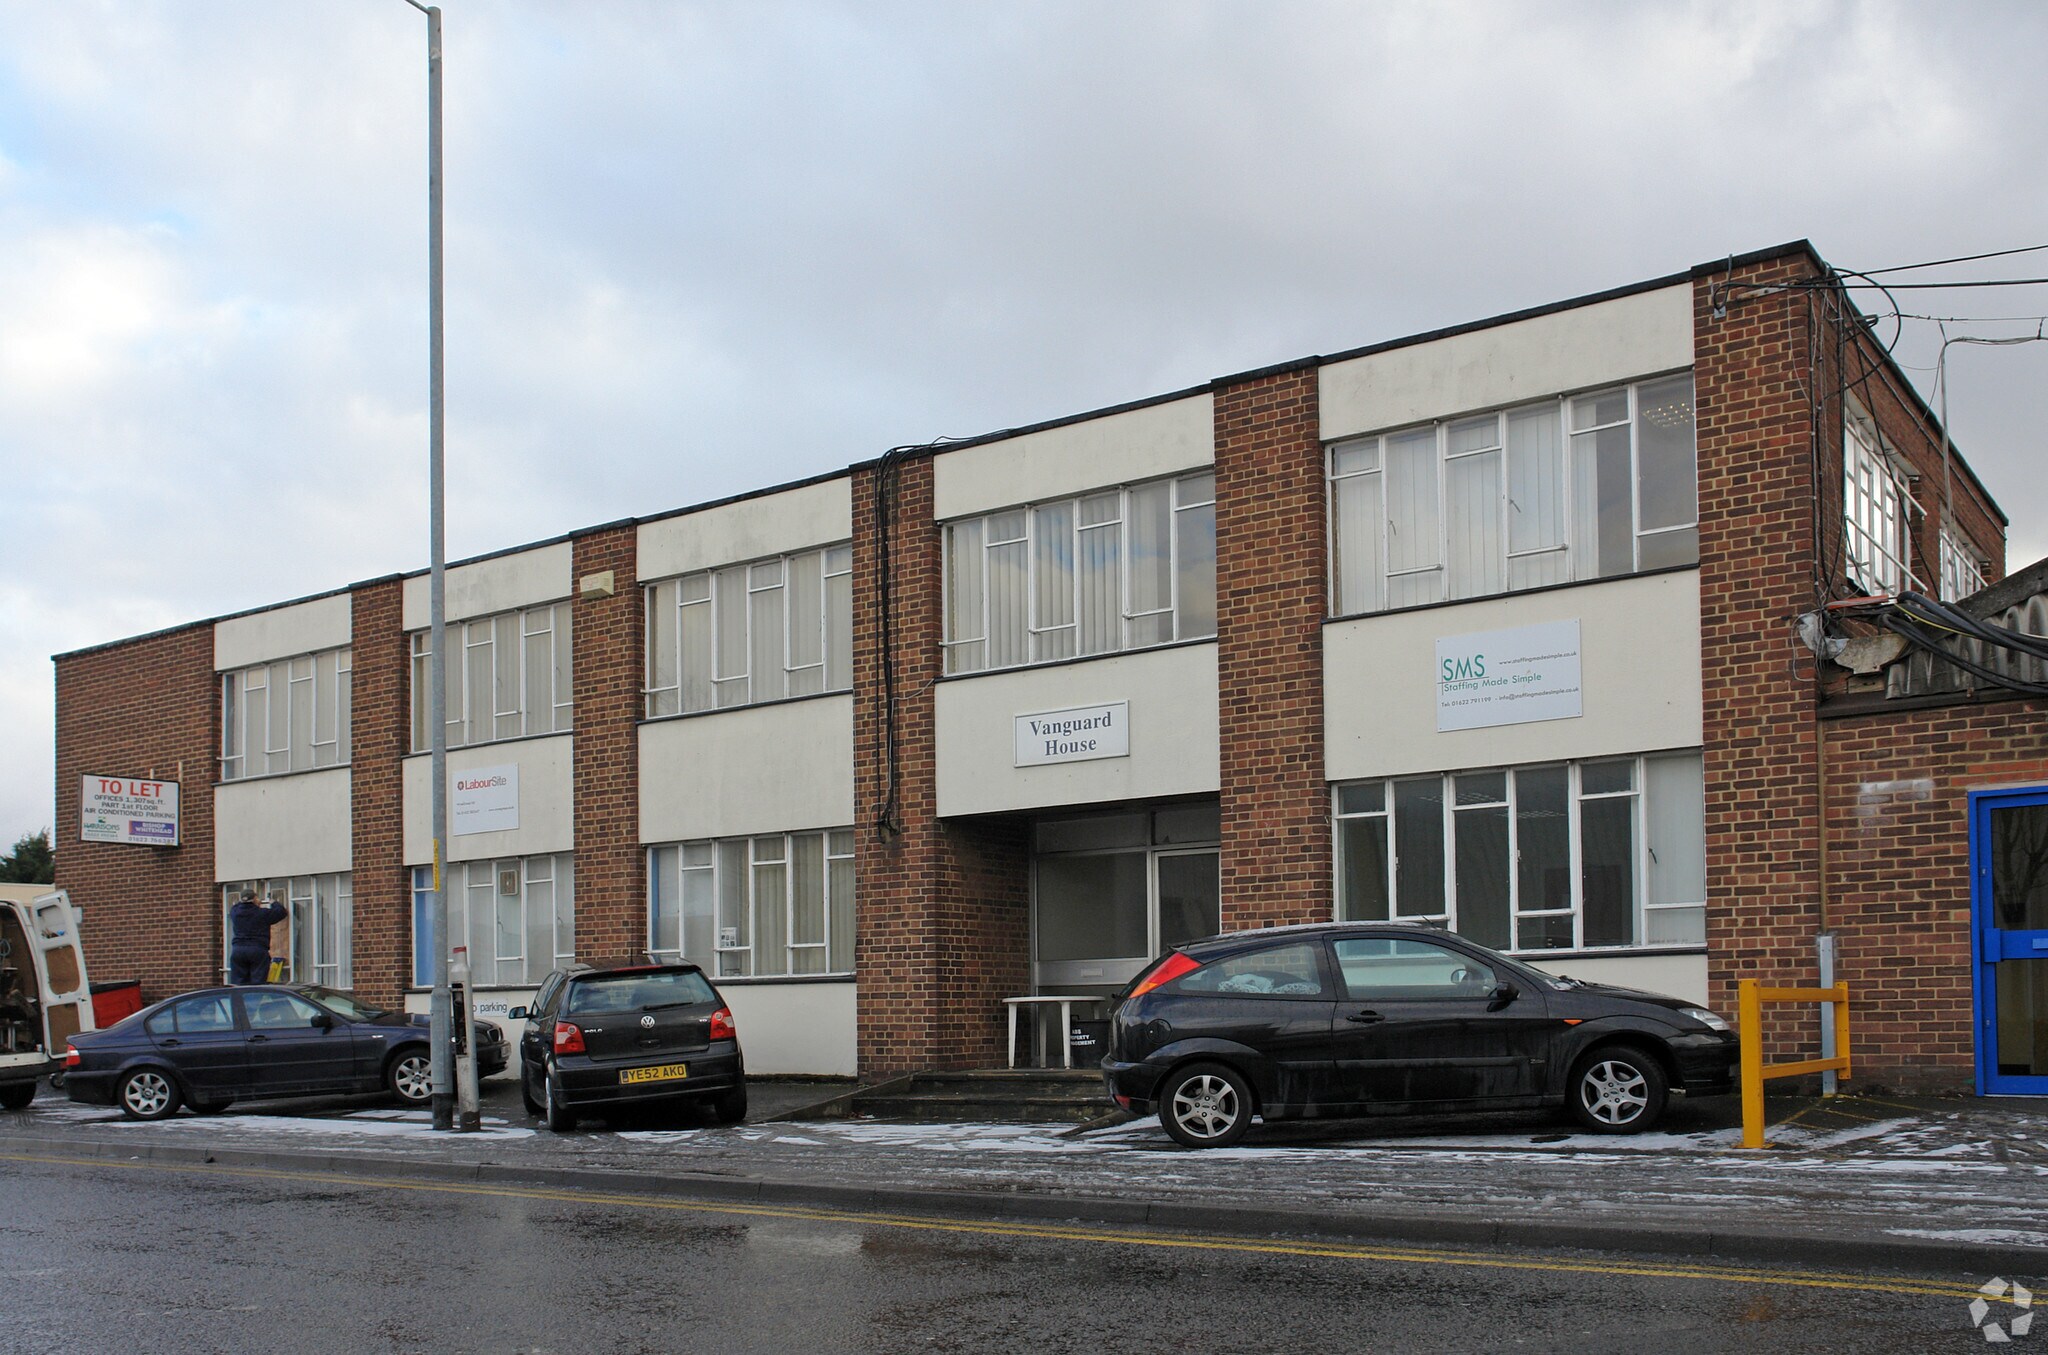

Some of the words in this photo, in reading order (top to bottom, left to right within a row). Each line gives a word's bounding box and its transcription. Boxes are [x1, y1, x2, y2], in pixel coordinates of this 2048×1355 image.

[1443, 654, 1485, 681] SMS
[1444, 681, 1479, 692] Staffing
[1482, 677, 1509, 687] Made
[1512, 672, 1542, 684] Simple
[1030, 712, 1111, 736] Vanguard
[1045, 739, 1097, 756] House
[98, 779, 122, 795] TO
[129, 781, 163, 798] LET
[465, 775, 507, 790] LabourSite
[94, 794, 124, 802] OFFICES
[98, 808, 144, 817] CONDITIONED
[145, 811, 176, 819] PARKING
[135, 826, 173, 834] WHITEHEAD
[480, 1002, 508, 1014] parking
[628, 1068, 660, 1081] YE52
[662, 1065, 685, 1078] AKO
